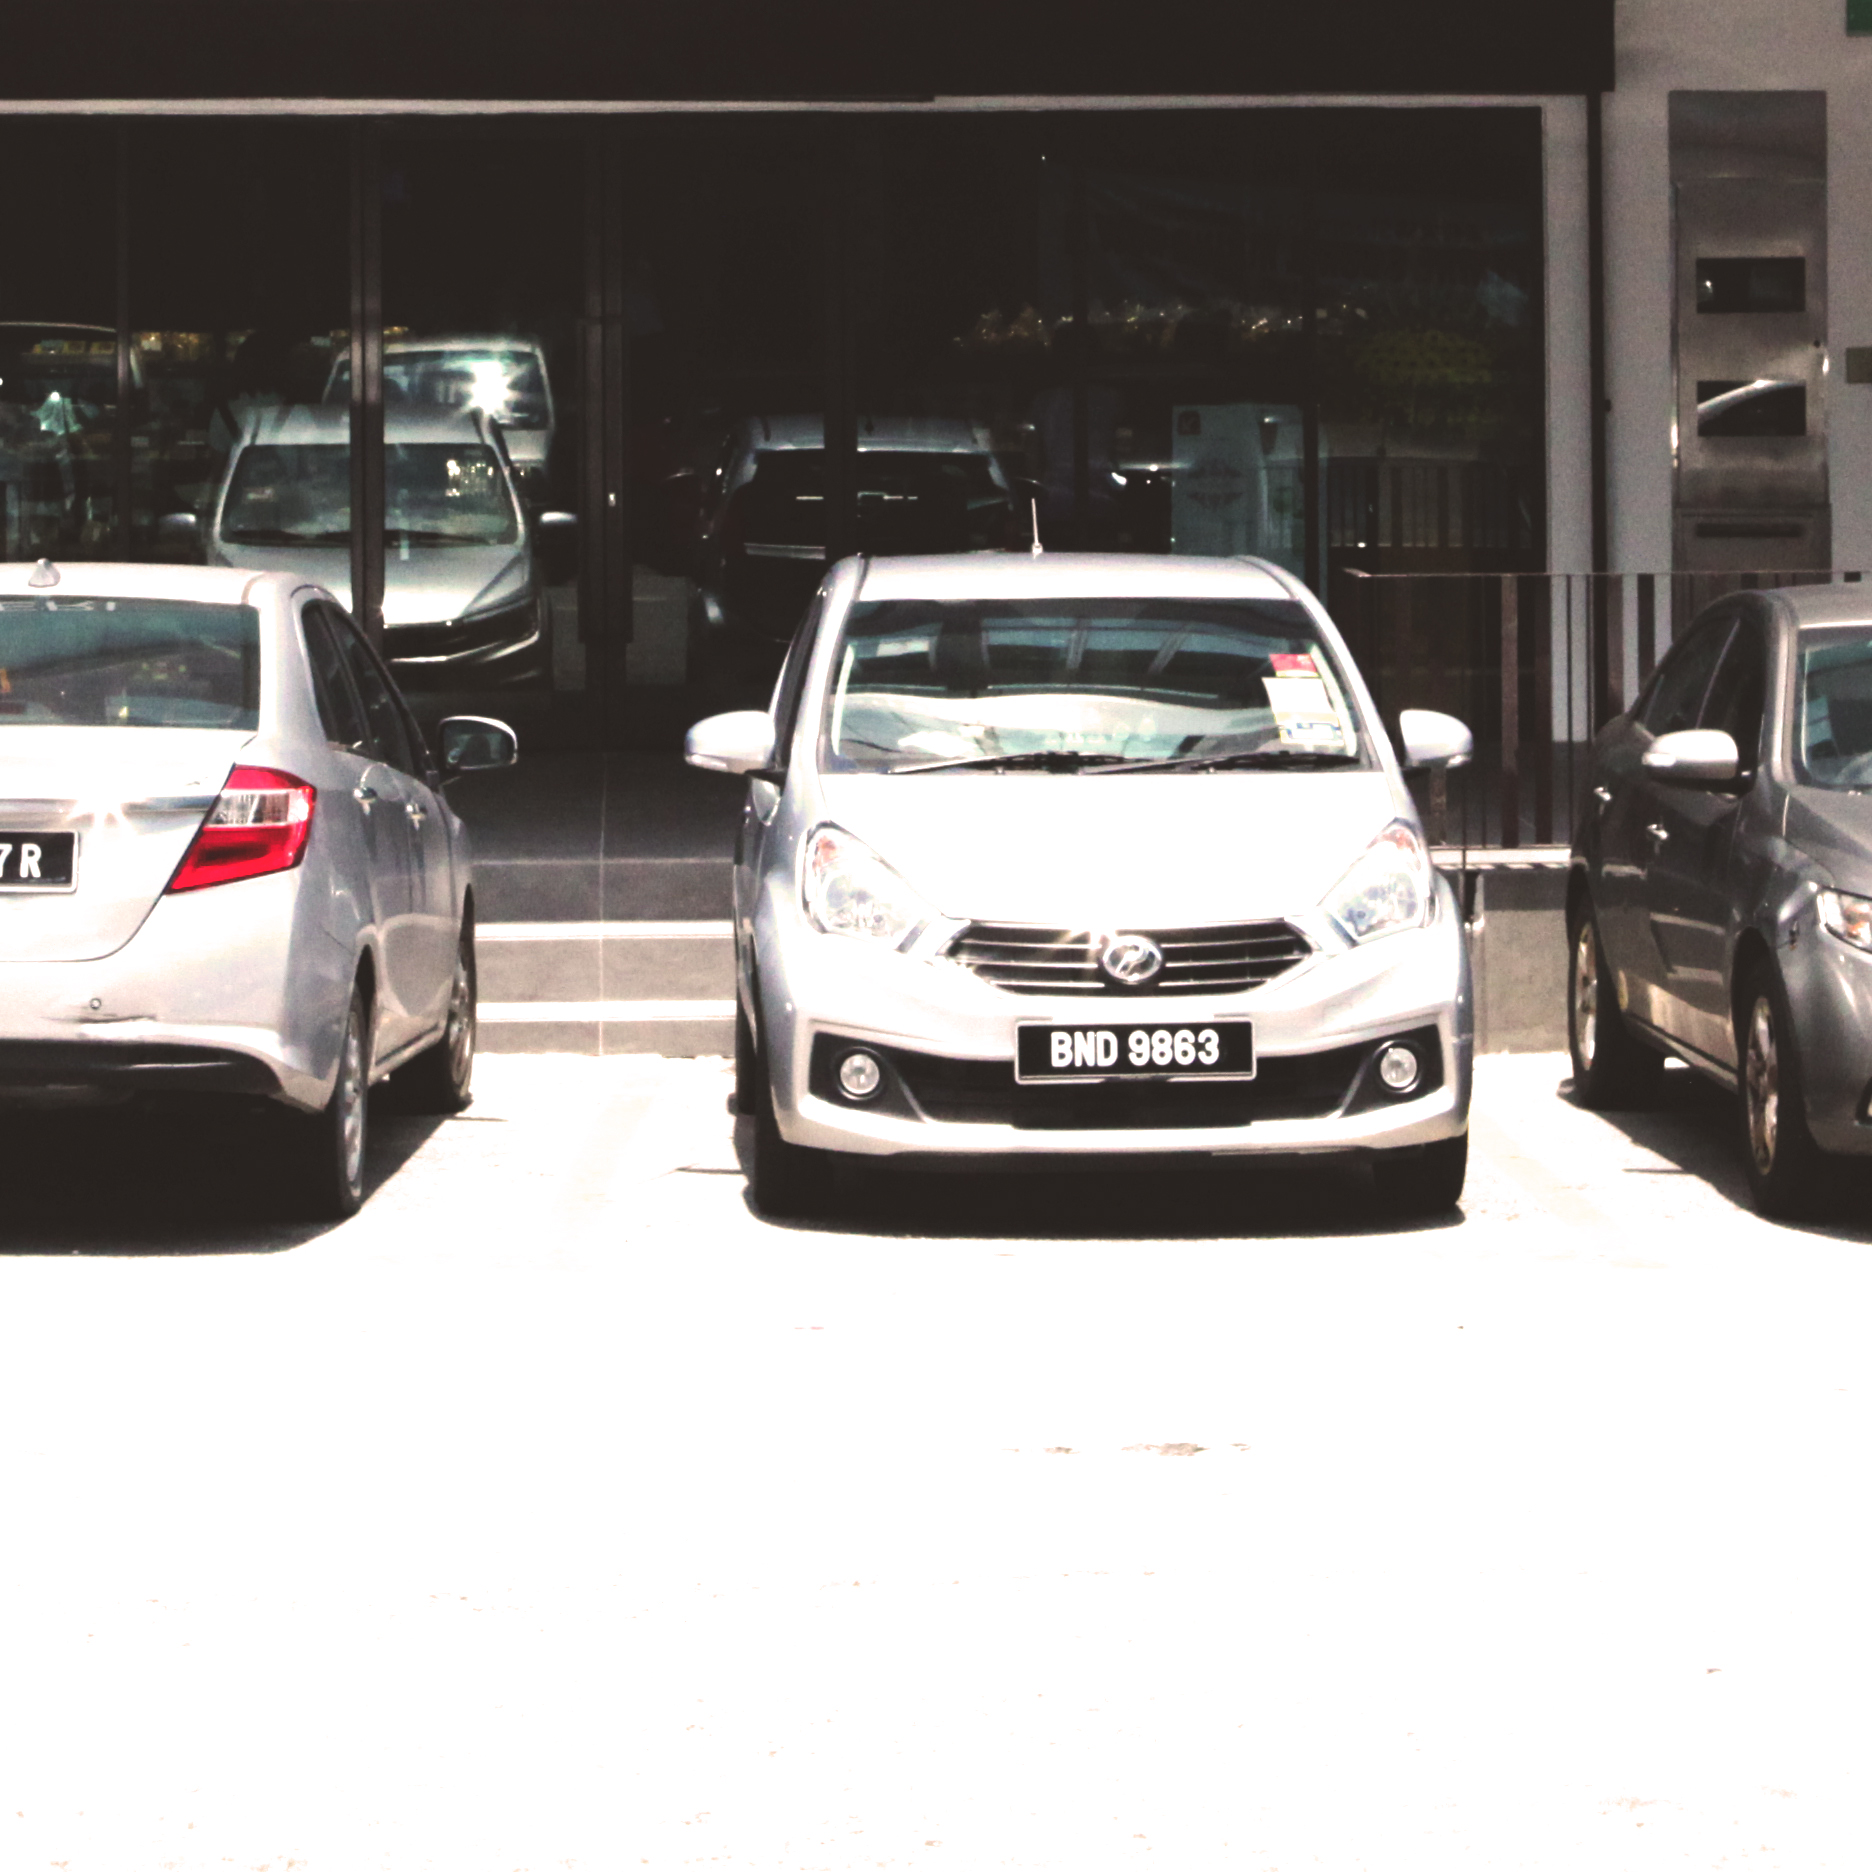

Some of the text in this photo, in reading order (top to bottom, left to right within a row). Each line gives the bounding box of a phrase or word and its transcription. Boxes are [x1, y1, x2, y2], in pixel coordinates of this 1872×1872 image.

[19, 842, 42, 879] R
[1049, 1029, 1221, 1069] BND 9863
